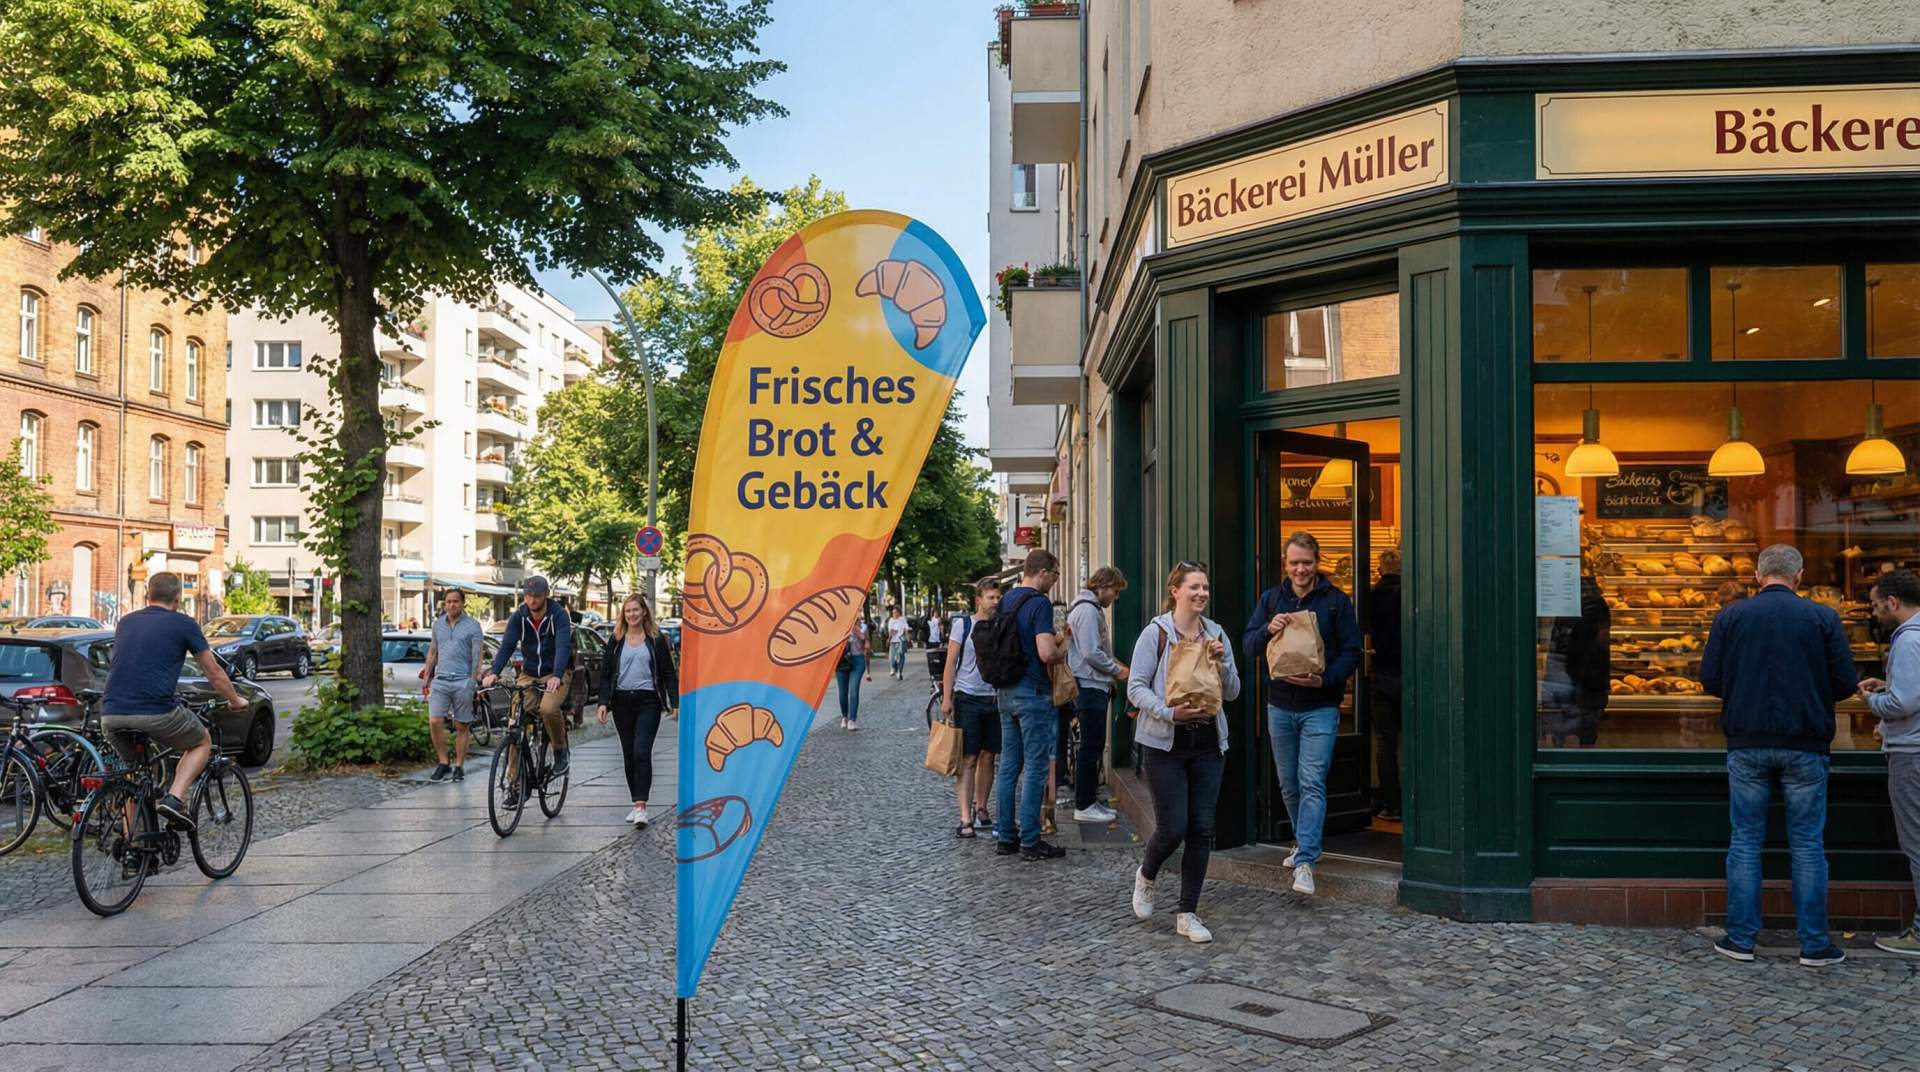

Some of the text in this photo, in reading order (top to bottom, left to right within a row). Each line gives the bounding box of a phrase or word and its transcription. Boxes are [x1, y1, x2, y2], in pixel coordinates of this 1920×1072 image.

[1714, 103, 1920, 154] Bäckere
[1177, 135, 1435, 228] Bäckerei Müller
[749, 365, 916, 405] Frisches
[748, 417, 884, 457] Brot &
[737, 470, 889, 510] Gebäck
